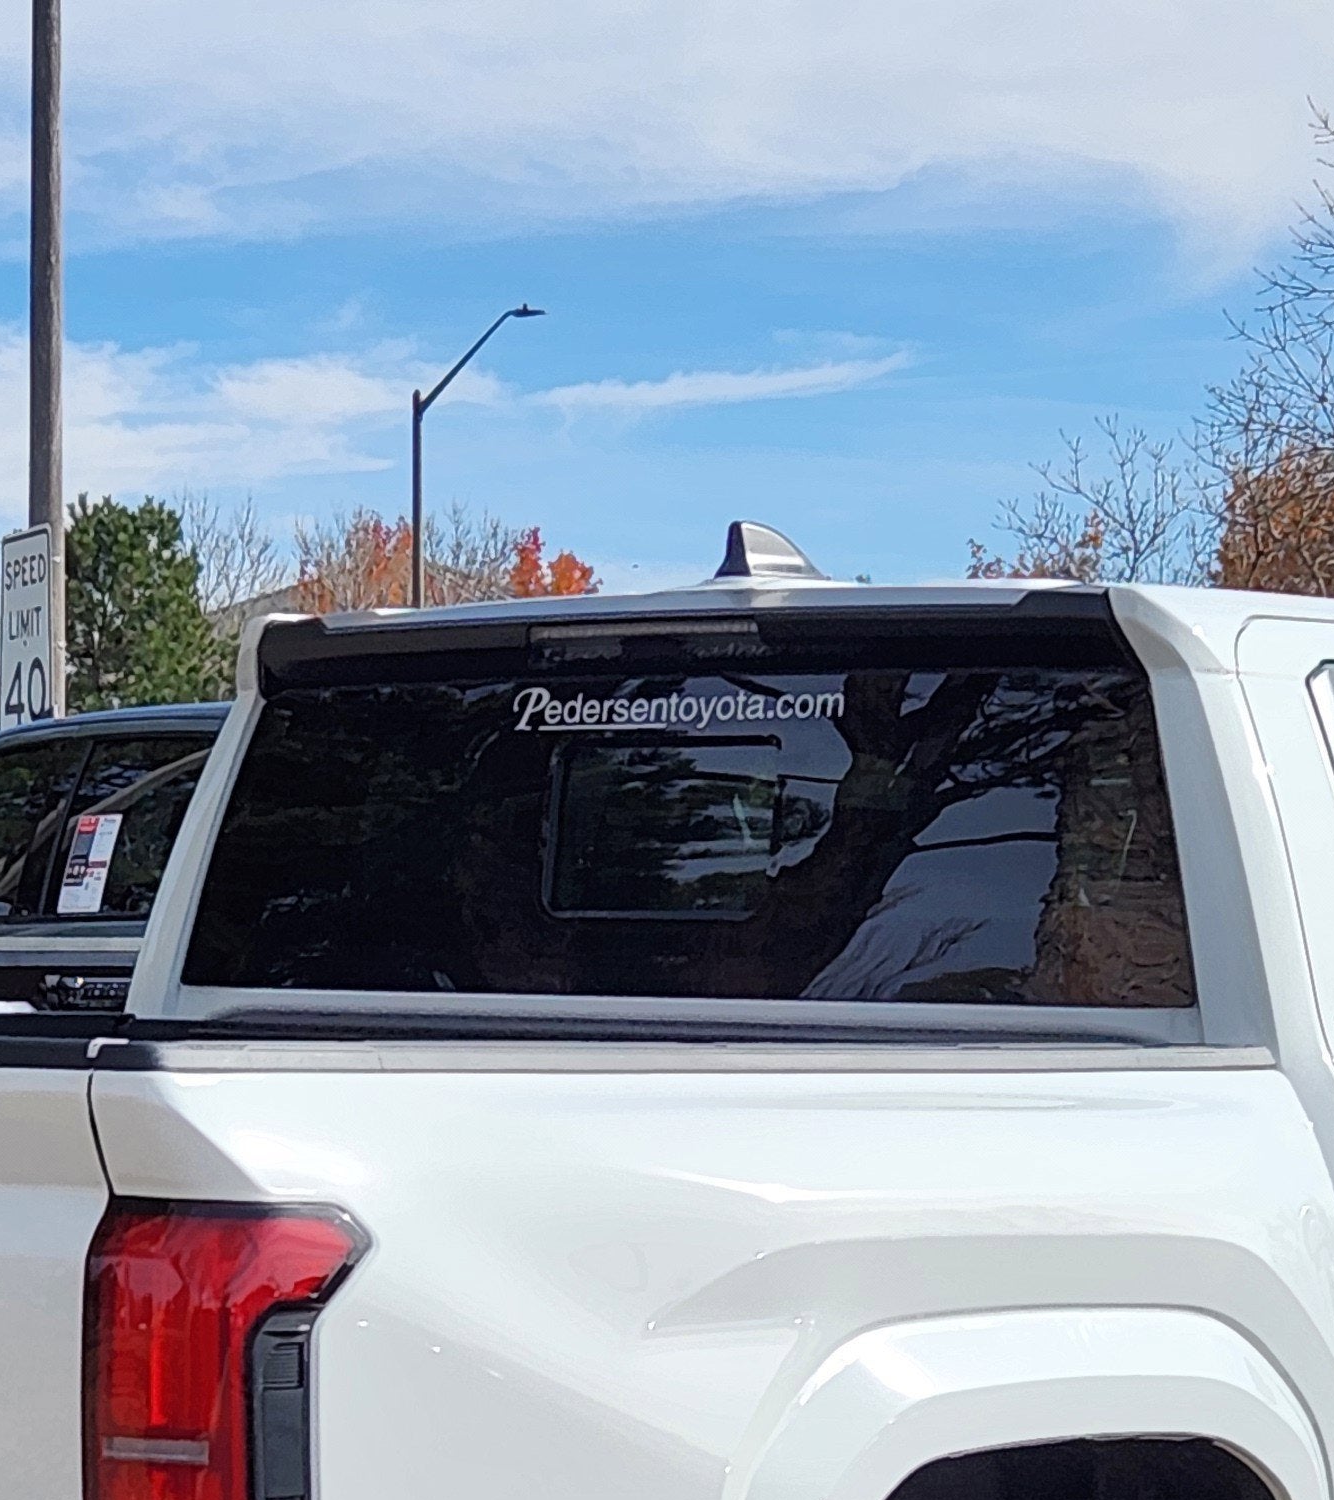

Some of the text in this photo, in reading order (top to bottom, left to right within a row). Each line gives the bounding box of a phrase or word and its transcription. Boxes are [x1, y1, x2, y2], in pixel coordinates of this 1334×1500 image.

[5, 553, 46, 591] SPEED
[8, 606, 42, 640] LIMIT
[5, 657, 47, 725] 40
[513, 686, 845, 732] Pedersentoyota.com
